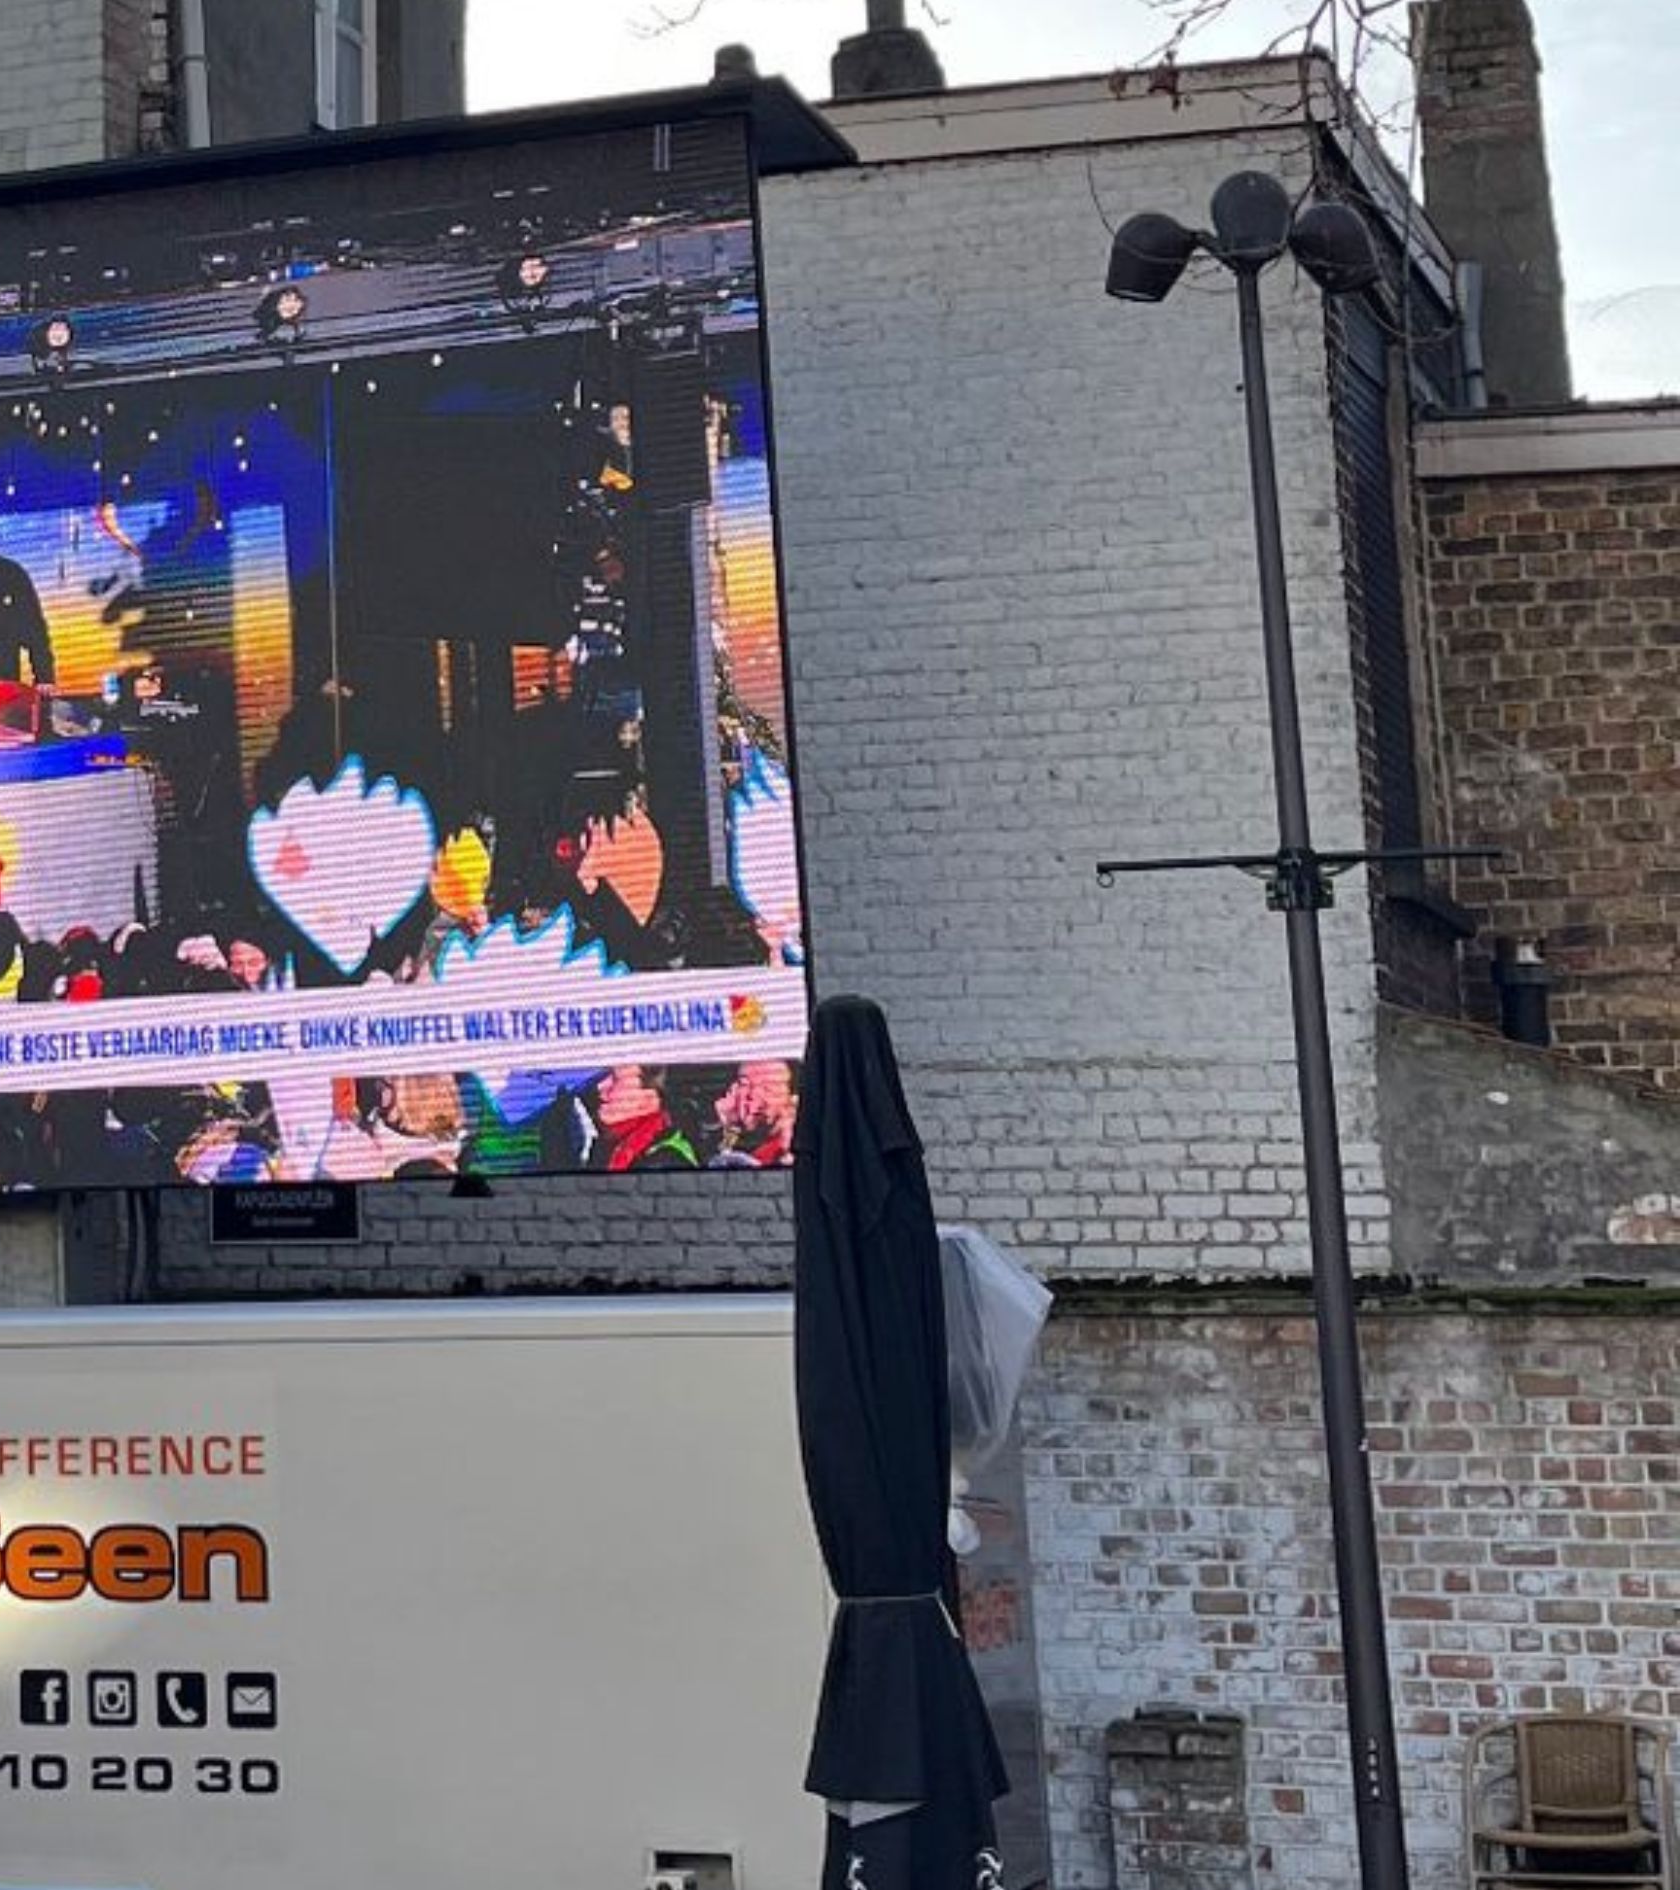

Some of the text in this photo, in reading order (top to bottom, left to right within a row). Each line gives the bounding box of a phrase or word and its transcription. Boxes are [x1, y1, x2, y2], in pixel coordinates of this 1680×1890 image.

[87, 1026, 214, 1057] VERJAARDAG
[299, 1017, 360, 1049] DIKKE
[367, 1014, 457, 1047] KNUFFEL
[463, 1009, 549, 1041] WALTER
[555, 1007, 582, 1038] EN
[588, 1000, 725, 1036] GUENDALINA
[91, 1757, 173, 1793] 20
[196, 1758, 279, 1794] 30
